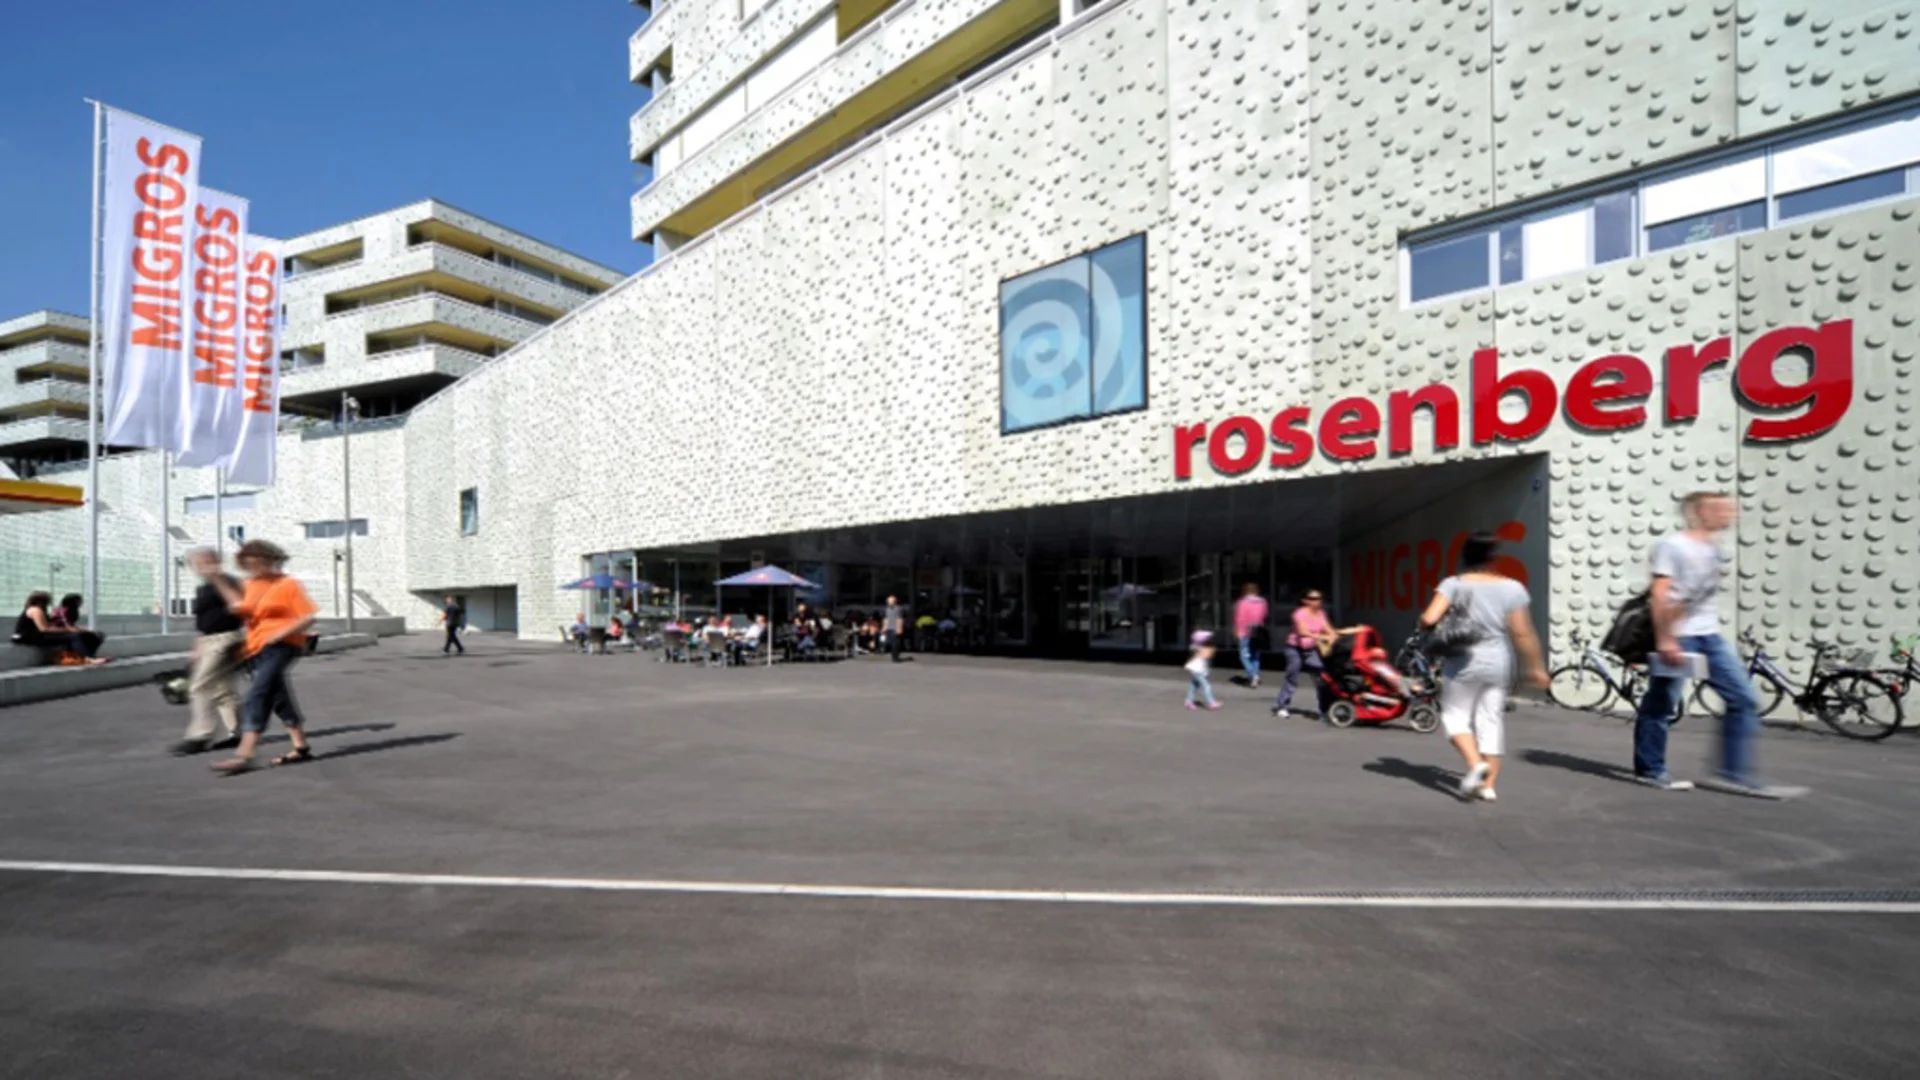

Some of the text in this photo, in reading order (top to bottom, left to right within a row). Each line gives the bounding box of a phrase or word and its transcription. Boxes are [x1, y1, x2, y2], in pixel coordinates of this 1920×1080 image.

[131, 136, 189, 350] MIGROS
[194, 203, 239, 388] MIGROS
[243, 249, 277, 413] MIGROS
[1174, 318, 1854, 480] rosenberg
